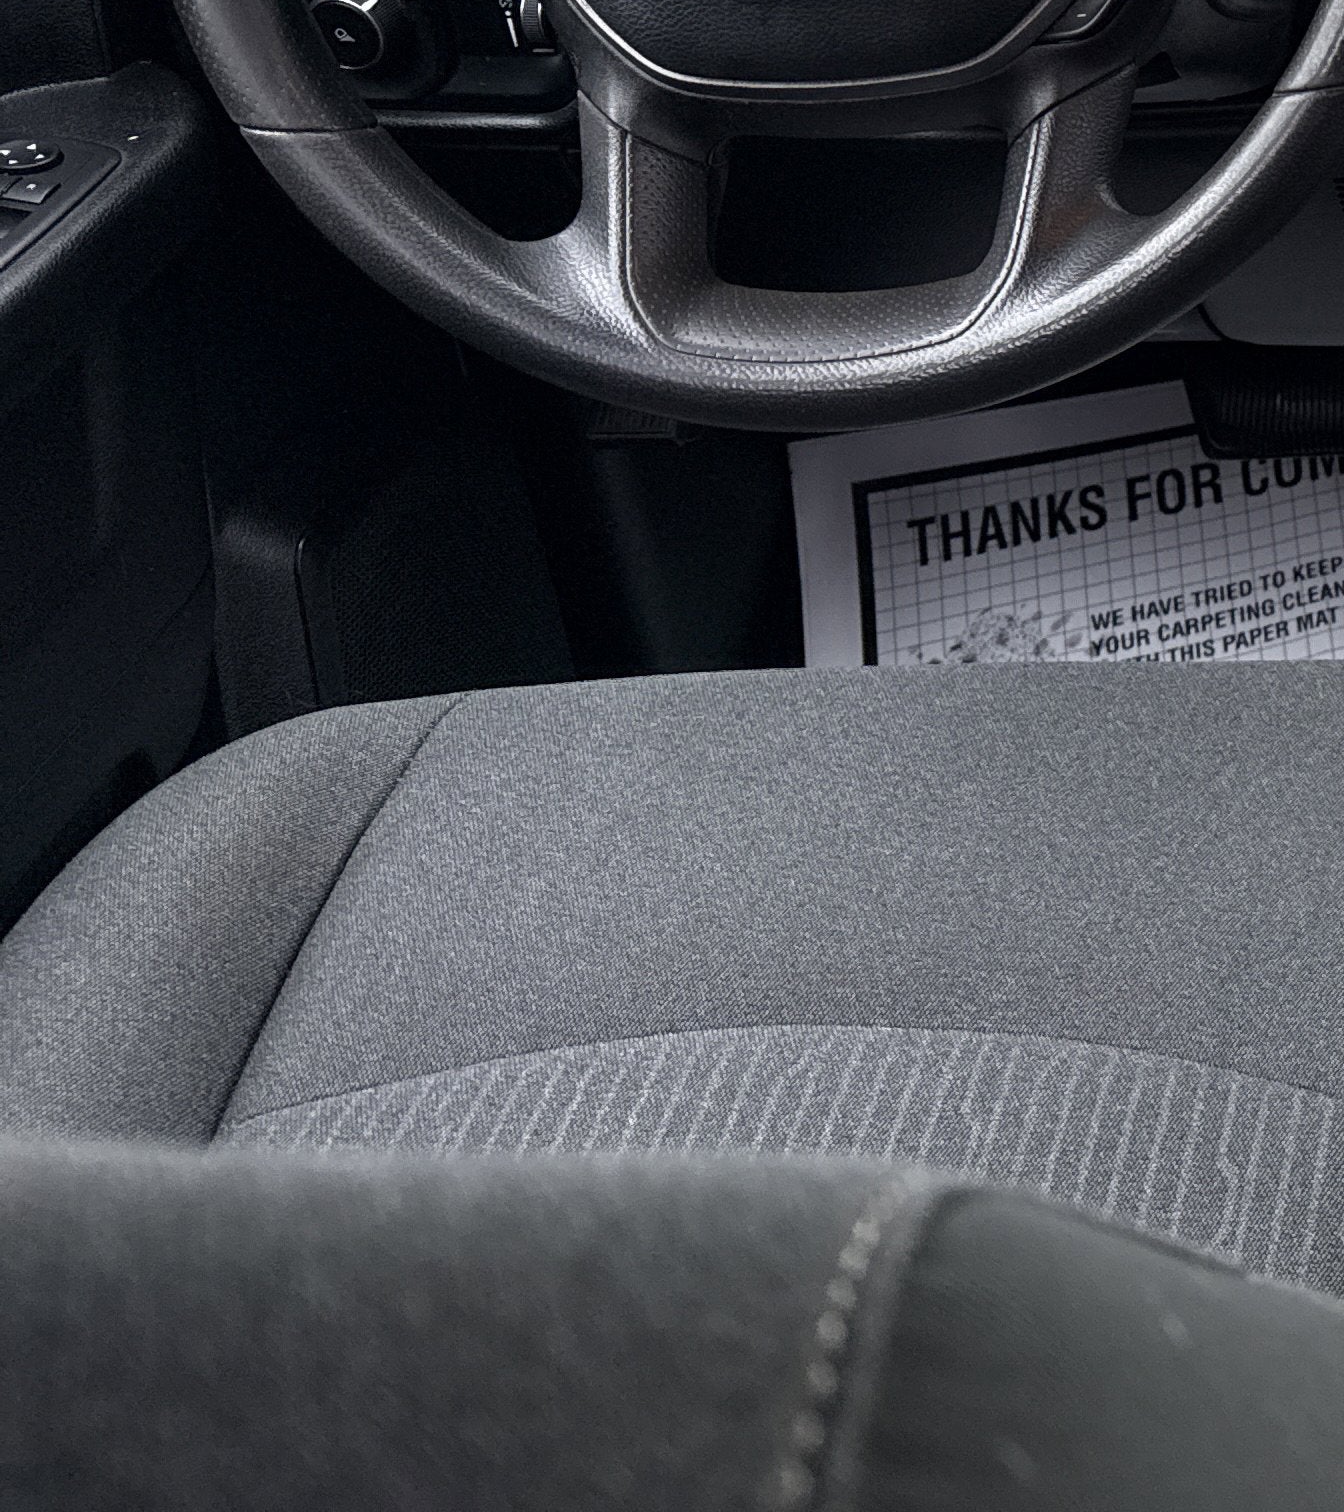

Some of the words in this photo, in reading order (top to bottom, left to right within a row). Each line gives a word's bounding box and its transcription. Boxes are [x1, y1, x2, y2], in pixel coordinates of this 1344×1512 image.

[907, 484, 1108, 568] THANKS
[1126, 457, 1224, 522] FOR
[1090, 611, 1125, 631] WE
[1131, 594, 1185, 623] HAVE
[1191, 579, 1253, 609] TRIED
[1260, 570, 1286, 592] TO
[1293, 556, 1344, 582] KEEP
[1090, 630, 1151, 657] YOUR
[1157, 599, 1276, 643] CARPETING
[1169, 637, 1215, 662] THIS
[1223, 620, 1290, 653] PAPER
[1296, 606, 1340, 634] MAT
